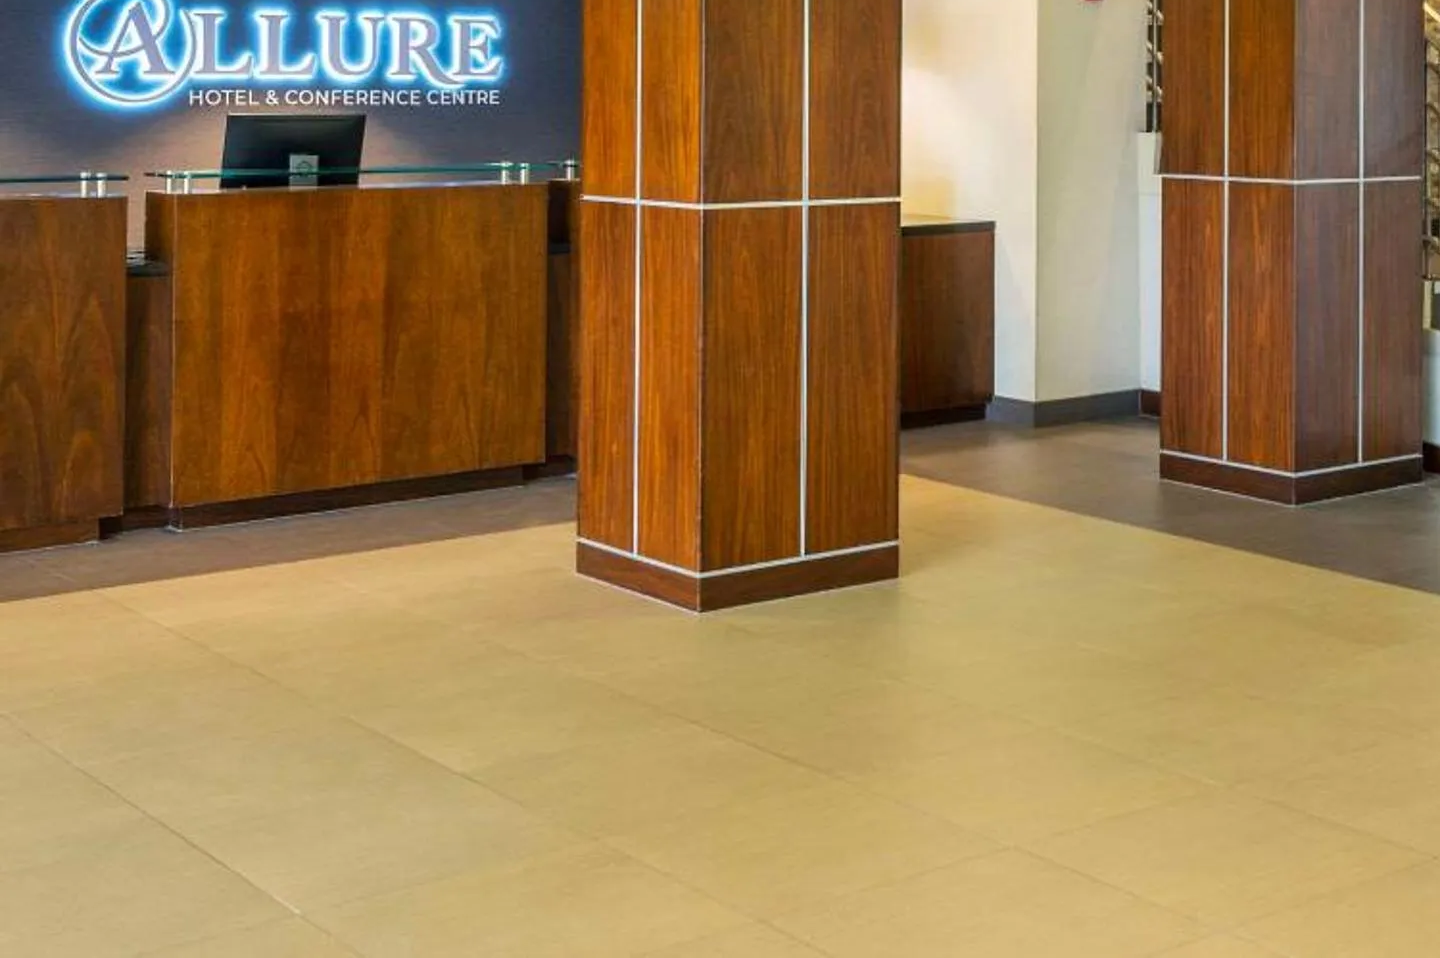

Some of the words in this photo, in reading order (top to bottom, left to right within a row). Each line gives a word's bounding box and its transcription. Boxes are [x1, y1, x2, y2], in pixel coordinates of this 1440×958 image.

[189, 89, 260, 106] HOTEL
[265, 89, 279, 106] &
[285, 89, 421, 106] CONFERENCE
[426, 89, 500, 106] CENTRE
